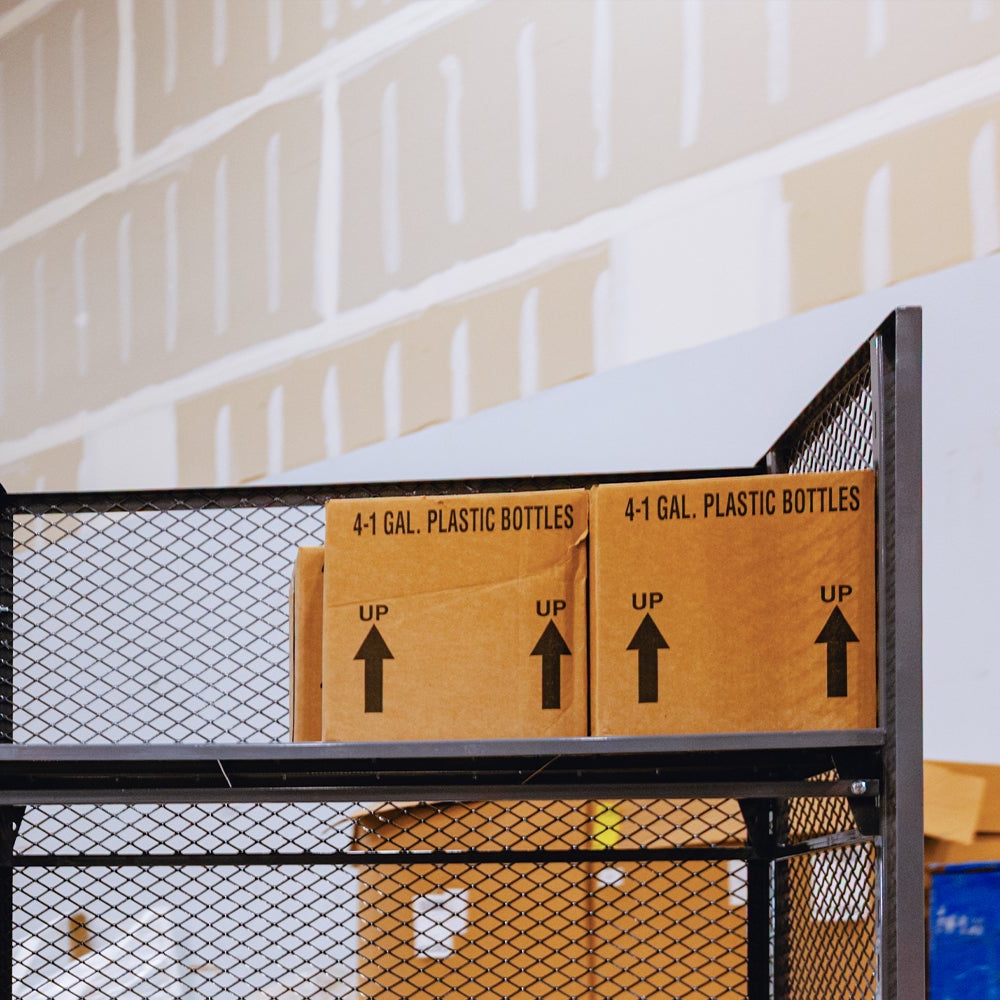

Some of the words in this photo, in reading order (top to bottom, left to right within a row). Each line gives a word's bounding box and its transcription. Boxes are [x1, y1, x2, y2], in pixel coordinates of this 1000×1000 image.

[625, 496, 649, 521] 4-1
[657, 494, 696, 520] GAL.
[704, 489, 776, 518] PLASTIC
[782, 485, 860, 514] BOTTLES
[353, 512, 377, 536] 4-1
[383, 510, 421, 535] GAL.
[427, 507, 496, 534] PLASTIC
[501, 504, 574, 531] BOTTLES
[632, 592, 664, 610] UP
[821, 585, 853, 603] UP
[359, 604, 389, 621] UP
[536, 600, 567, 617] UP
